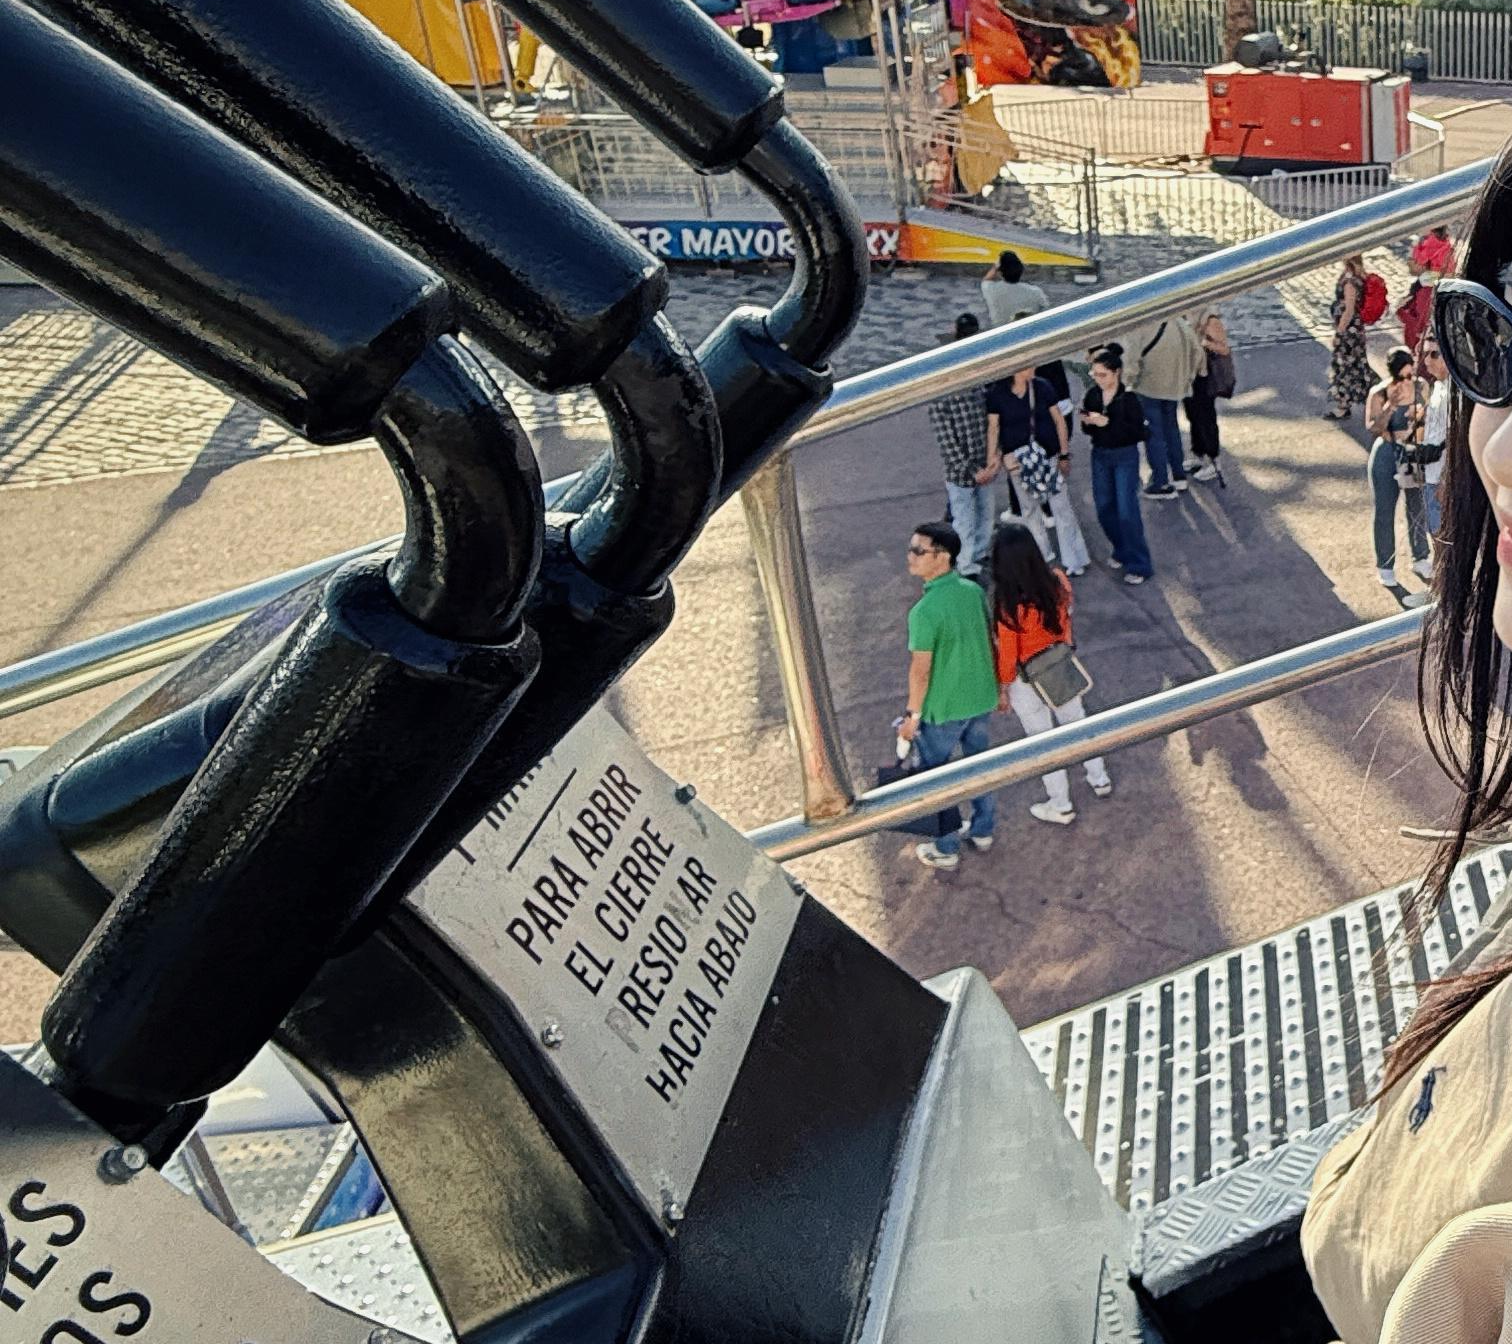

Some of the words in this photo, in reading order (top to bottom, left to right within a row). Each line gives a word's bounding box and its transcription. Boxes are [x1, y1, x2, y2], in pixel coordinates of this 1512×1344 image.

[681, 227, 797, 256] MAYOR
[505, 855, 589, 965] PARA
[567, 764, 642, 871] ABRIR
[564, 940, 615, 997] EL
[594, 817, 675, 943] CIERRE
[645, 988, 717, 1104] HACIA
[697, 890, 757, 999] ABAJO
